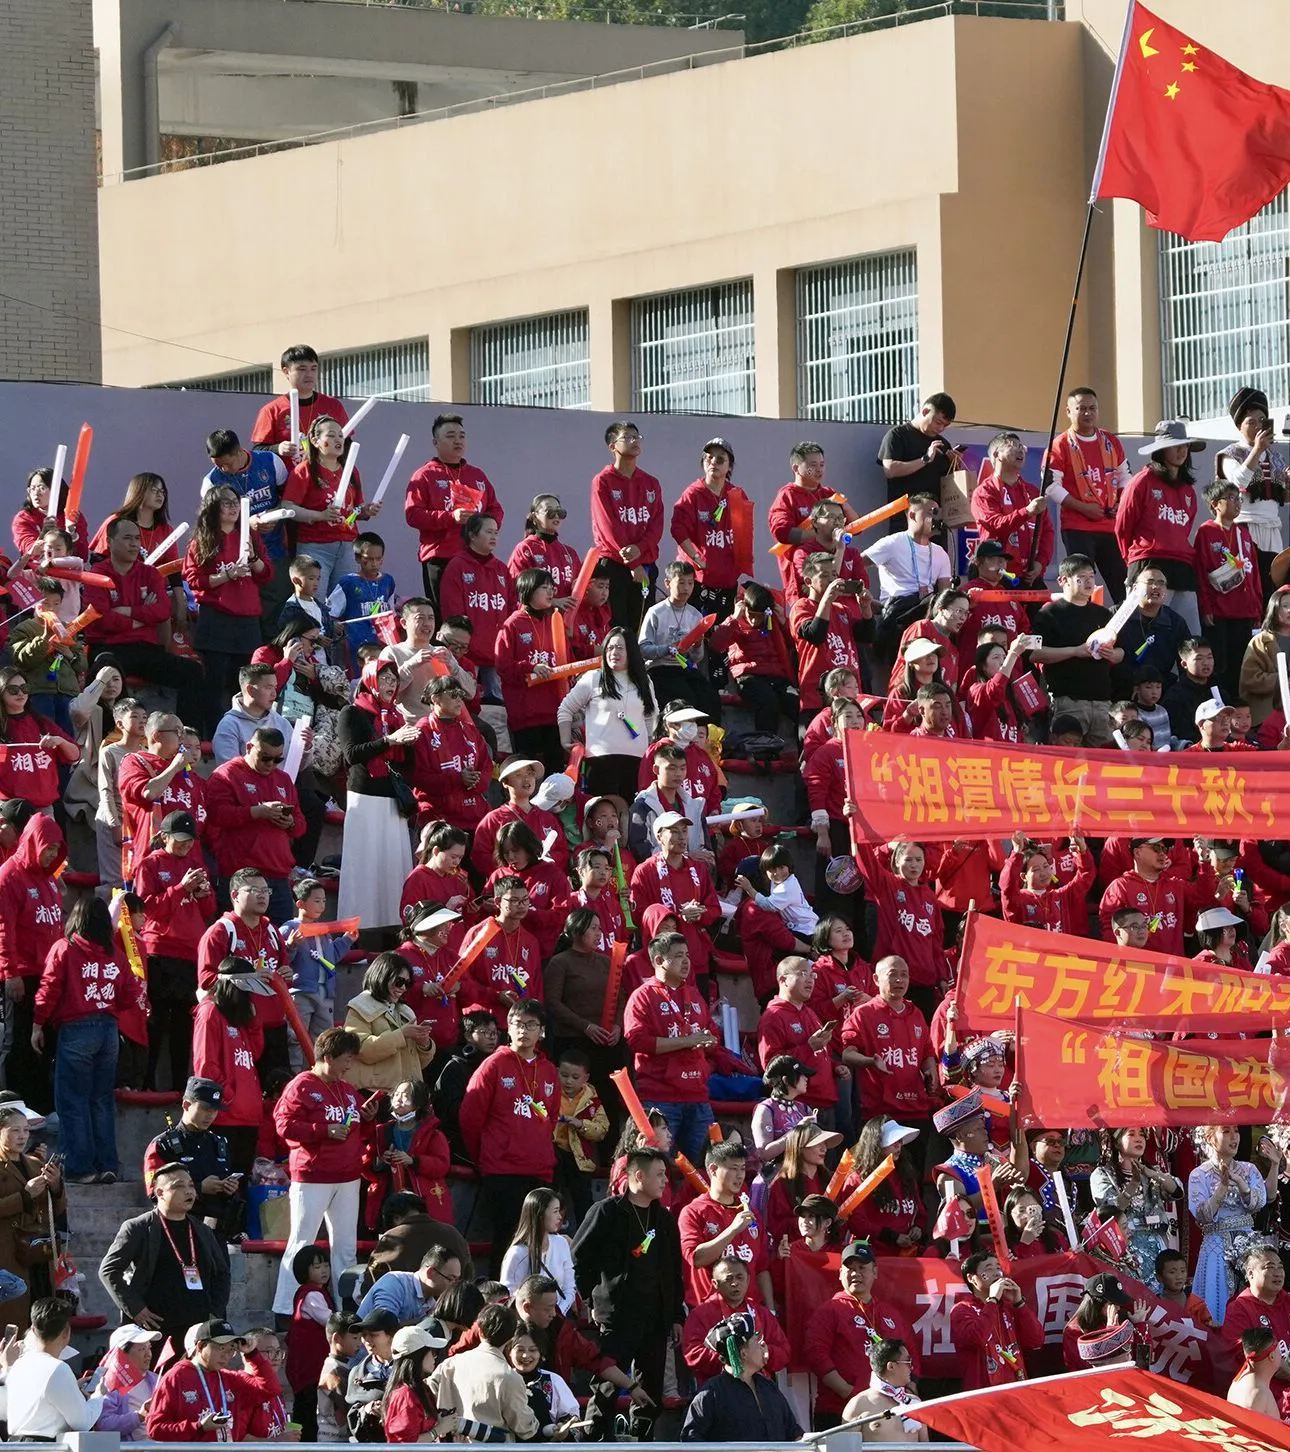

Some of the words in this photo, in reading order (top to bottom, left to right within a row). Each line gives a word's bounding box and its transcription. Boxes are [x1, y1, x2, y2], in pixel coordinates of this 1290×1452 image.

[617, 506, 650, 526] 湘西
[1157, 505, 1191, 526] 湘西
[467, 590, 505, 612] 湘西
[980, 614, 1017, 633] 湘西
[826, 633, 849, 666] 湘西
[10, 751, 52, 773] 湘西
[898, 908, 932, 936] 湘西
[81, 961, 120, 981] 湘西
[881, 1046, 917, 1068] 湘西
